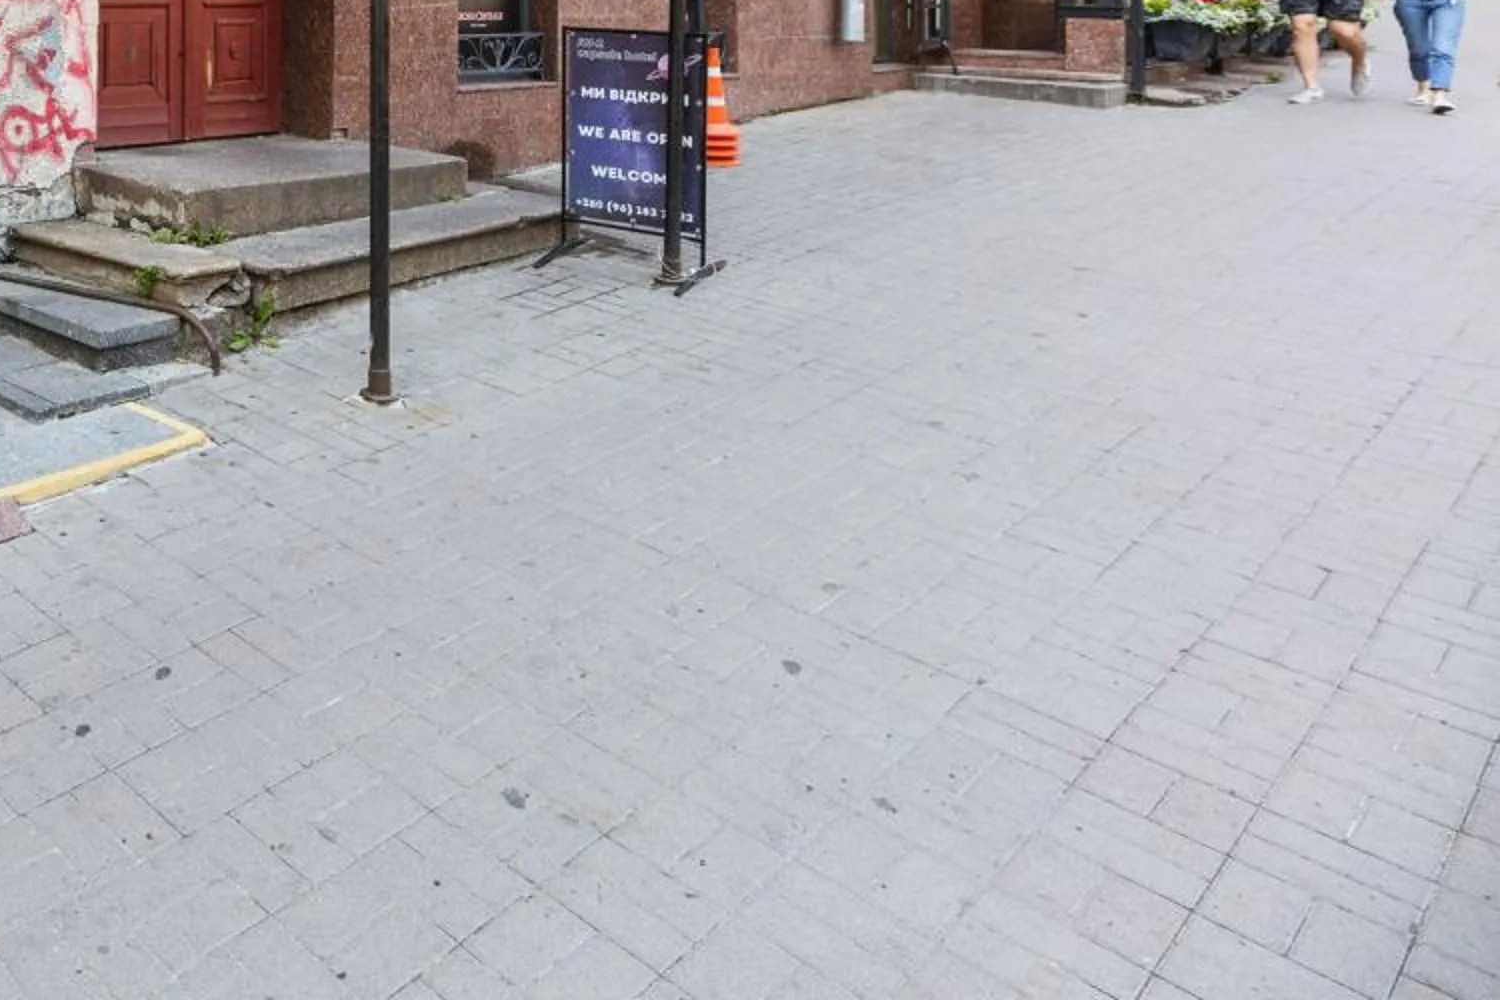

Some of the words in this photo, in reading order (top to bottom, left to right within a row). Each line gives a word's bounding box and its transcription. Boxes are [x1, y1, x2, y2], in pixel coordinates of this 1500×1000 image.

[581, 86, 605, 99] МИ
[578, 124, 605, 139] WE
[609, 128, 642, 142] ARE
[646, 131, 694, 149] OPN
[590, 164, 668, 185] WELCOM
